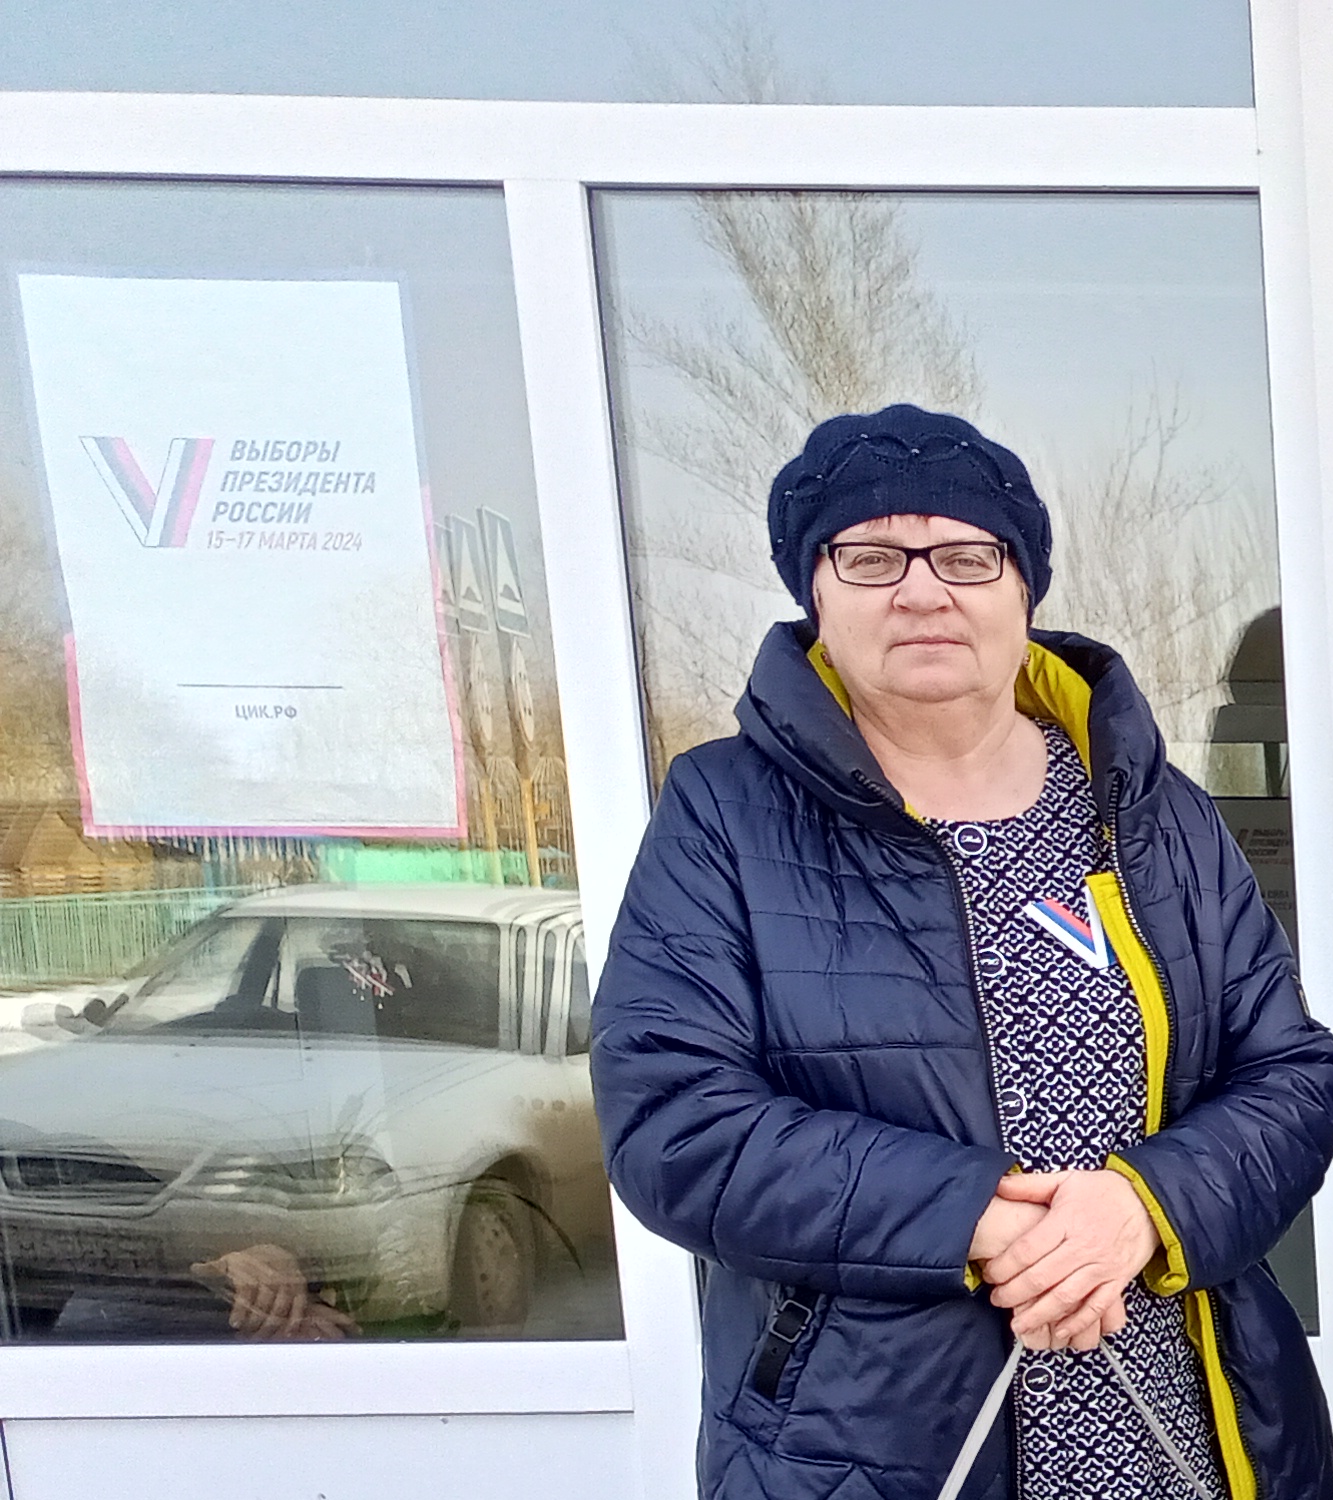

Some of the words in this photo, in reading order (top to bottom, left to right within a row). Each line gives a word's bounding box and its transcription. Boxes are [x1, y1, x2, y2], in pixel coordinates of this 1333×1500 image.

[229, 439, 341, 463] ВЫБОРЫ
[219, 470, 377, 497] ПРЕЗИДЕНТА
[211, 501, 313, 524] РОССИИ
[258, 530, 318, 550] МАРТА
[321, 531, 363, 551] 2024
[235, 704, 298, 721] ЦИК.РФ
